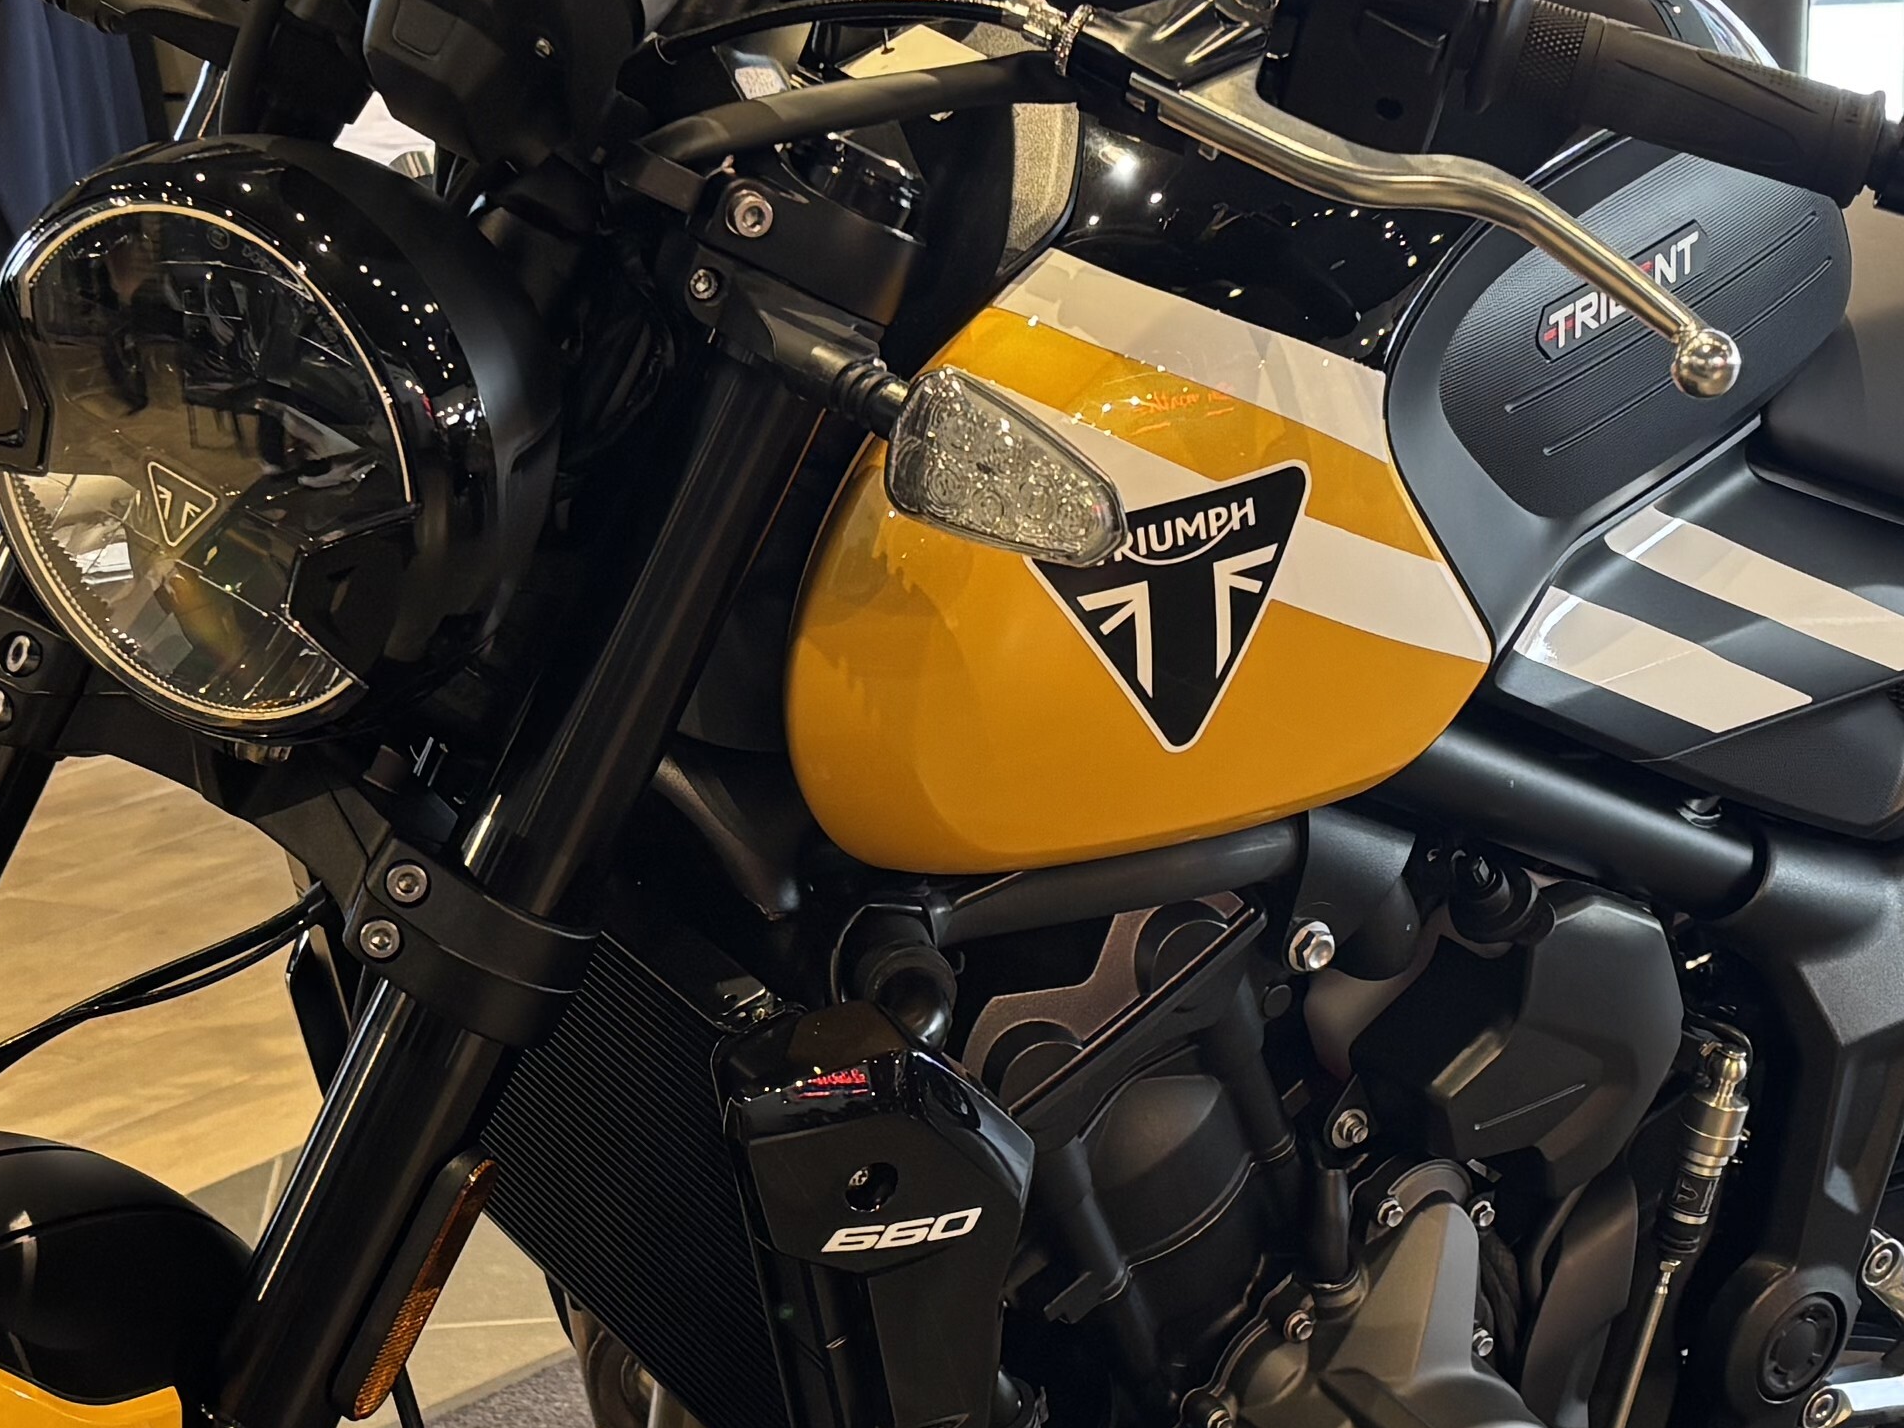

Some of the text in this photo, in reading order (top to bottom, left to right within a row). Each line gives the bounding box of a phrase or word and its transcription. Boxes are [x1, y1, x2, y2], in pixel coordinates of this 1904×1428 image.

[1546, 230, 1700, 350] TRINT
[1096, 496, 1257, 567] RIUMPH
[820, 1206, 983, 1254] 660
